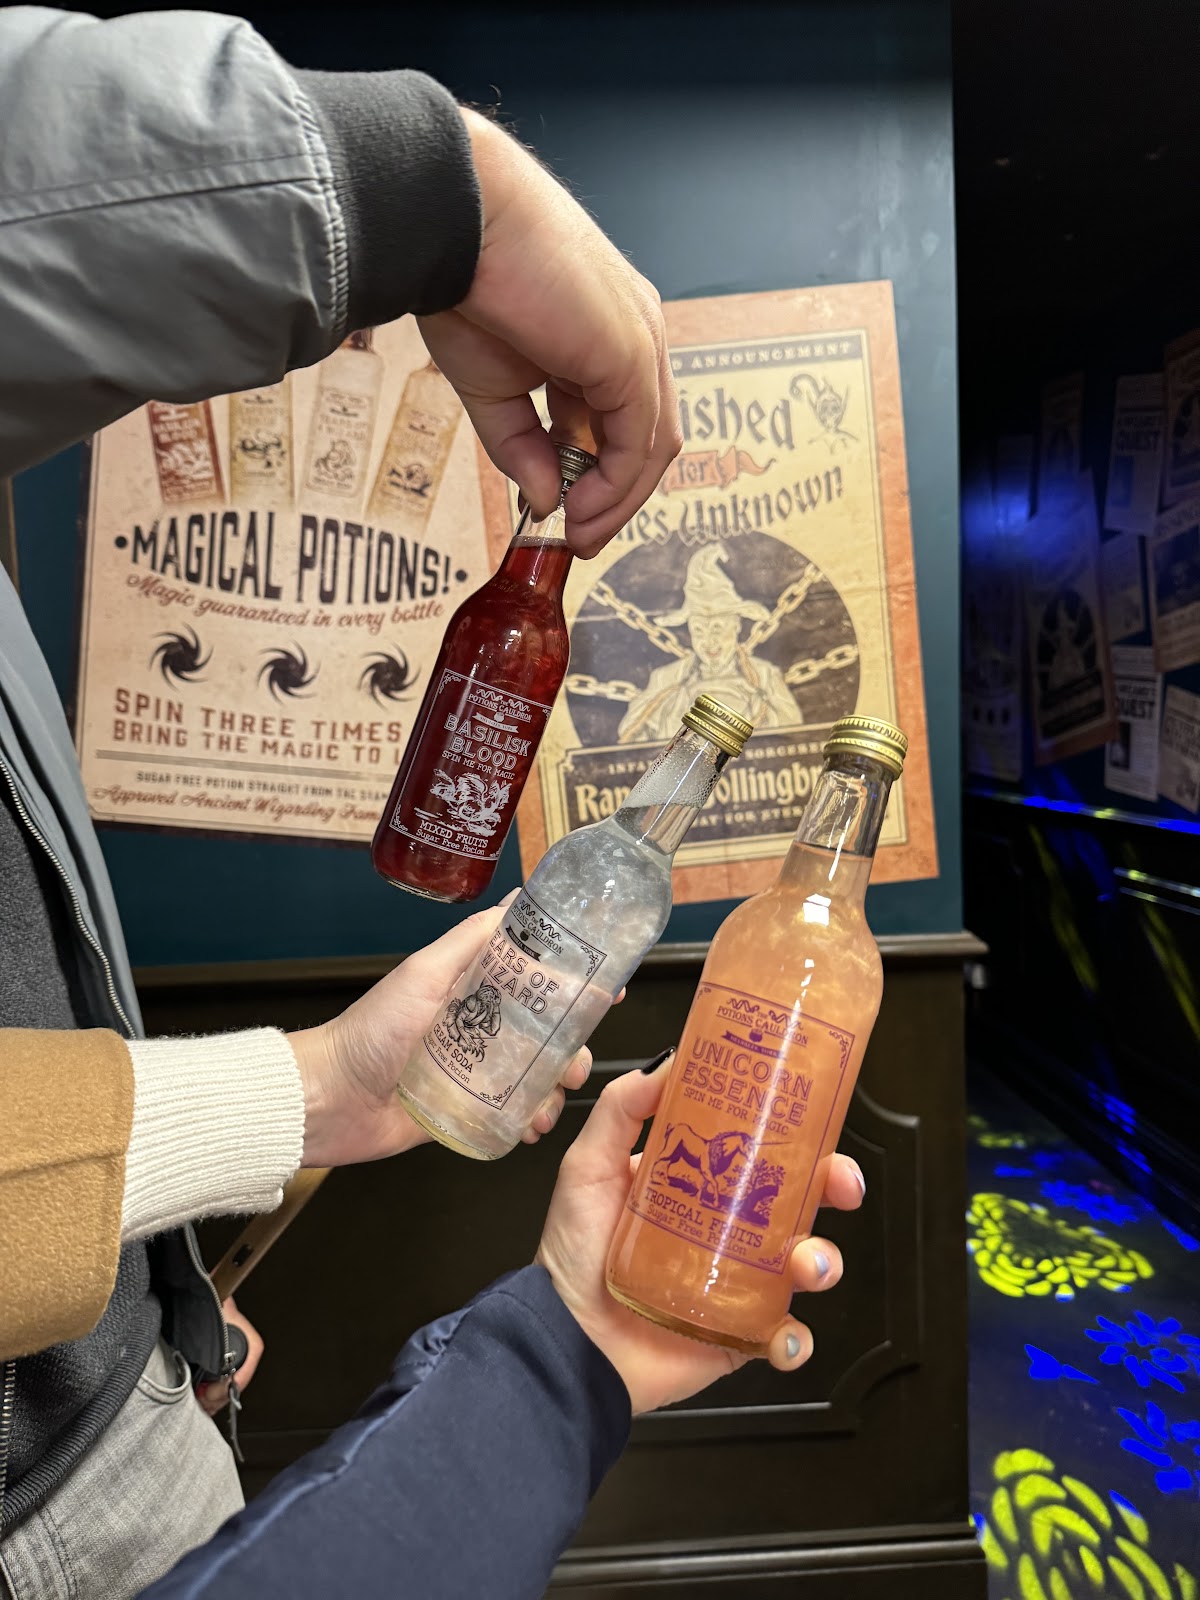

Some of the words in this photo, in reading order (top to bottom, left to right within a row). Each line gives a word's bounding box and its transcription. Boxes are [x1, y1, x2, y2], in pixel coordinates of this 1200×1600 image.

[692, 342, 851, 369] ANNOUNCEMENT
[678, 459, 708, 484] for
[677, 466, 843, 545] Unknown
[132, 511, 282, 600] MAGICAL
[296, 513, 451, 604] POTIONS!
[126, 574, 195, 607] Magic
[193, 597, 310, 627] guaranteed
[313, 608, 332, 627] in
[339, 611, 386, 636] every
[391, 600, 444, 624] bottle
[115, 688, 183, 723] SPIN
[201, 706, 295, 737] THREE
[312, 720, 402, 742] TIMES
[468, 694, 498, 710] POTIONS
[499, 705, 532, 721] CAULDRON
[113, 720, 188, 747] BRING
[202, 732, 248, 753] THE
[260, 740, 339, 760] MAGIC
[352, 745, 381, 764] TO
[444, 712, 531, 756] BASILISK
[449, 735, 517, 770] BLOOD
[442, 750, 461, 763] SPIN
[463, 758, 476, 768] ME
[476, 763, 492, 774] FOR
[494, 768, 515, 780] MAGIC
[420, 820, 453, 839] MIXED
[455, 833, 489, 848] FRUITS
[725, 811, 756, 825] FOR
[416, 829, 440, 843] Sugar
[442, 838, 460, 849] Free
[462, 844, 485, 855] Potion
[528, 922, 564, 954] CAULDRON
[481, 949, 548, 1014] WIZARD
[489, 926, 528, 975] EARS
[529, 969, 560, 996] OF
[717, 1005, 753, 1024] POTIONS
[434, 1023, 452, 1051] CREAM
[451, 1049, 473, 1073] SODA
[436, 1047, 447, 1062] Free
[447, 1060, 470, 1083] Potion
[692, 1036, 813, 1101] UNICORN
[681, 1061, 808, 1126] ESSENCE
[684, 1087, 705, 1102] SPIN
[707, 1096, 724, 1110] ME
[726, 1104, 749, 1120] FOR
[644, 1186, 703, 1226] TROPICAL
[709, 1217, 764, 1248] FRUITS
[647, 1203, 675, 1224] Sugar
[677, 1220, 702, 1237] Free
[707, 1232, 747, 1255] Poion
